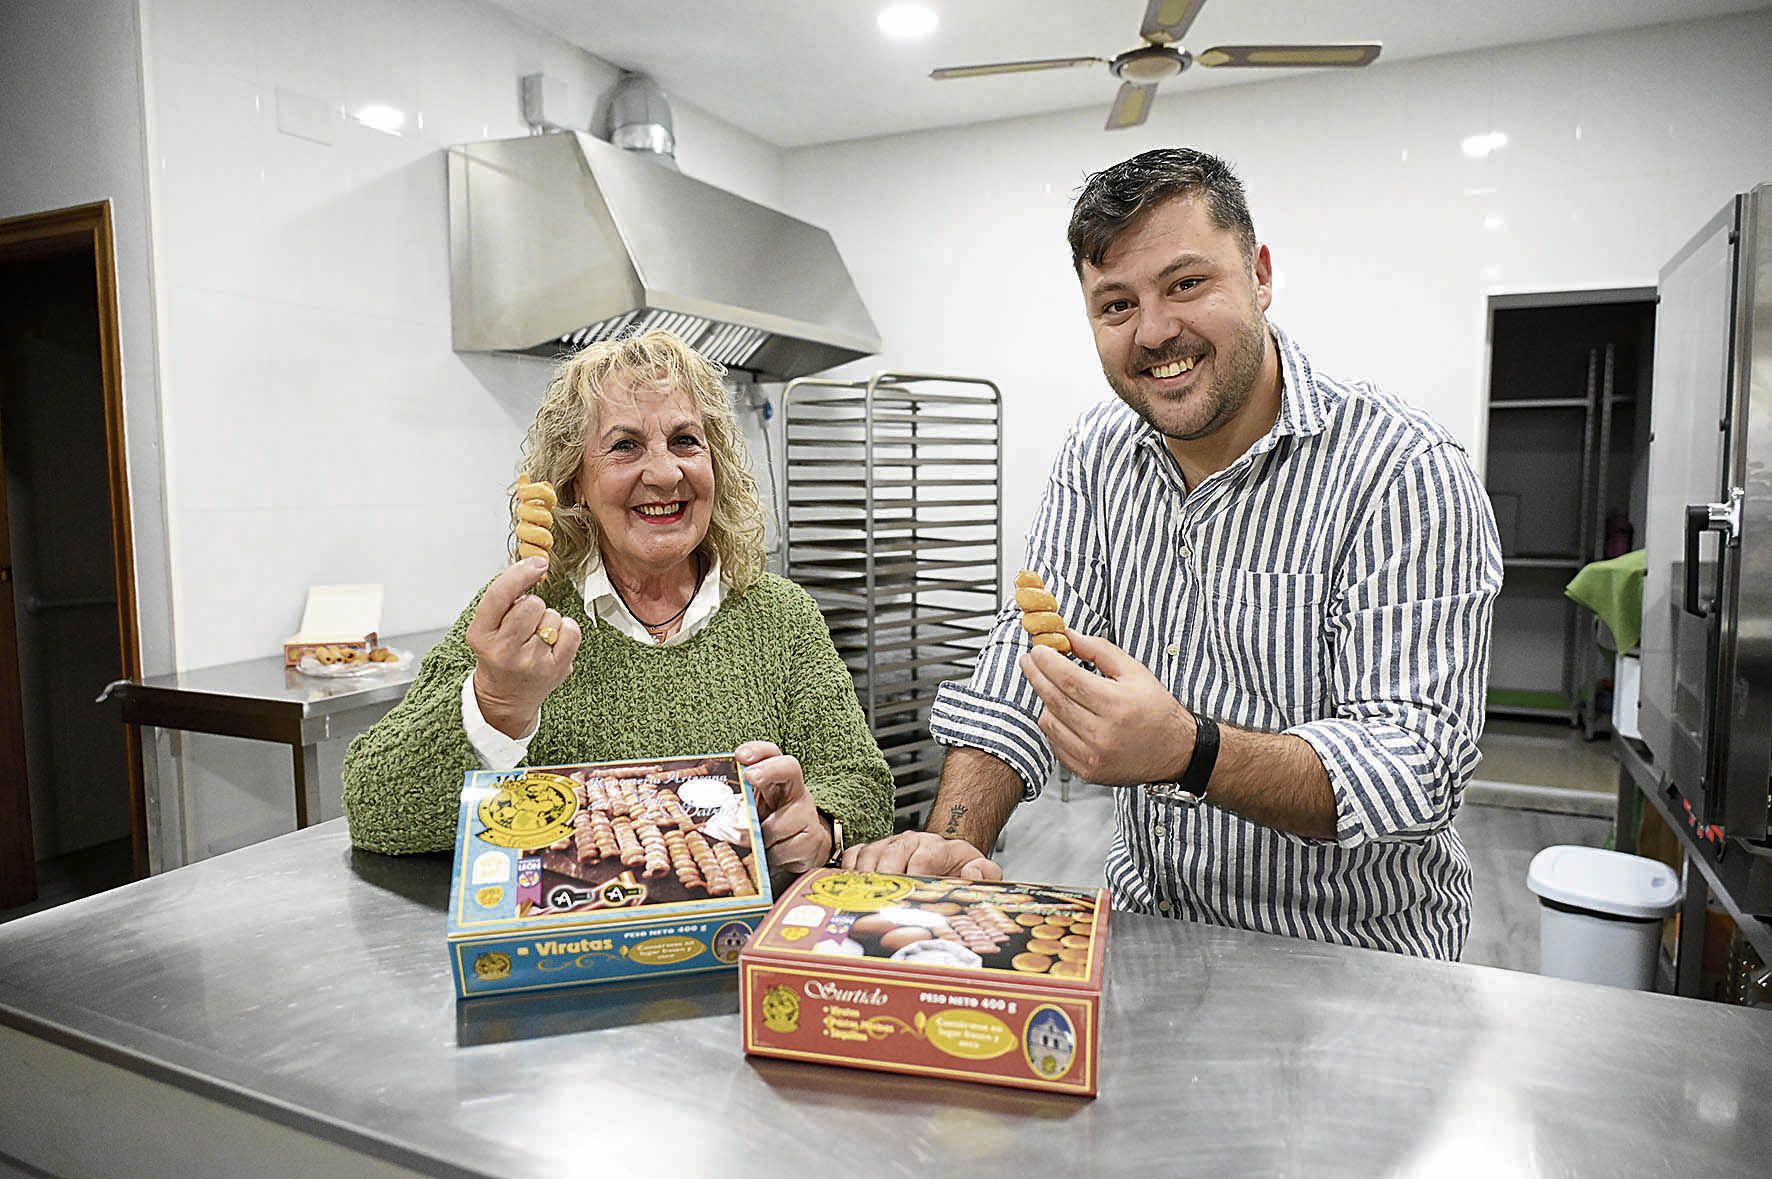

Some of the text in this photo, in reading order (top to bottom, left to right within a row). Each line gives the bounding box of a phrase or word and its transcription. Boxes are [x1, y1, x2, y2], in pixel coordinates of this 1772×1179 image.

[677, 925, 698, 933] 400
[535, 939, 613, 956] Virutas
[804, 980, 888, 1006] Surtido
[948, 995, 979, 1008] NETO
[981, 998, 1006, 1010] 400
